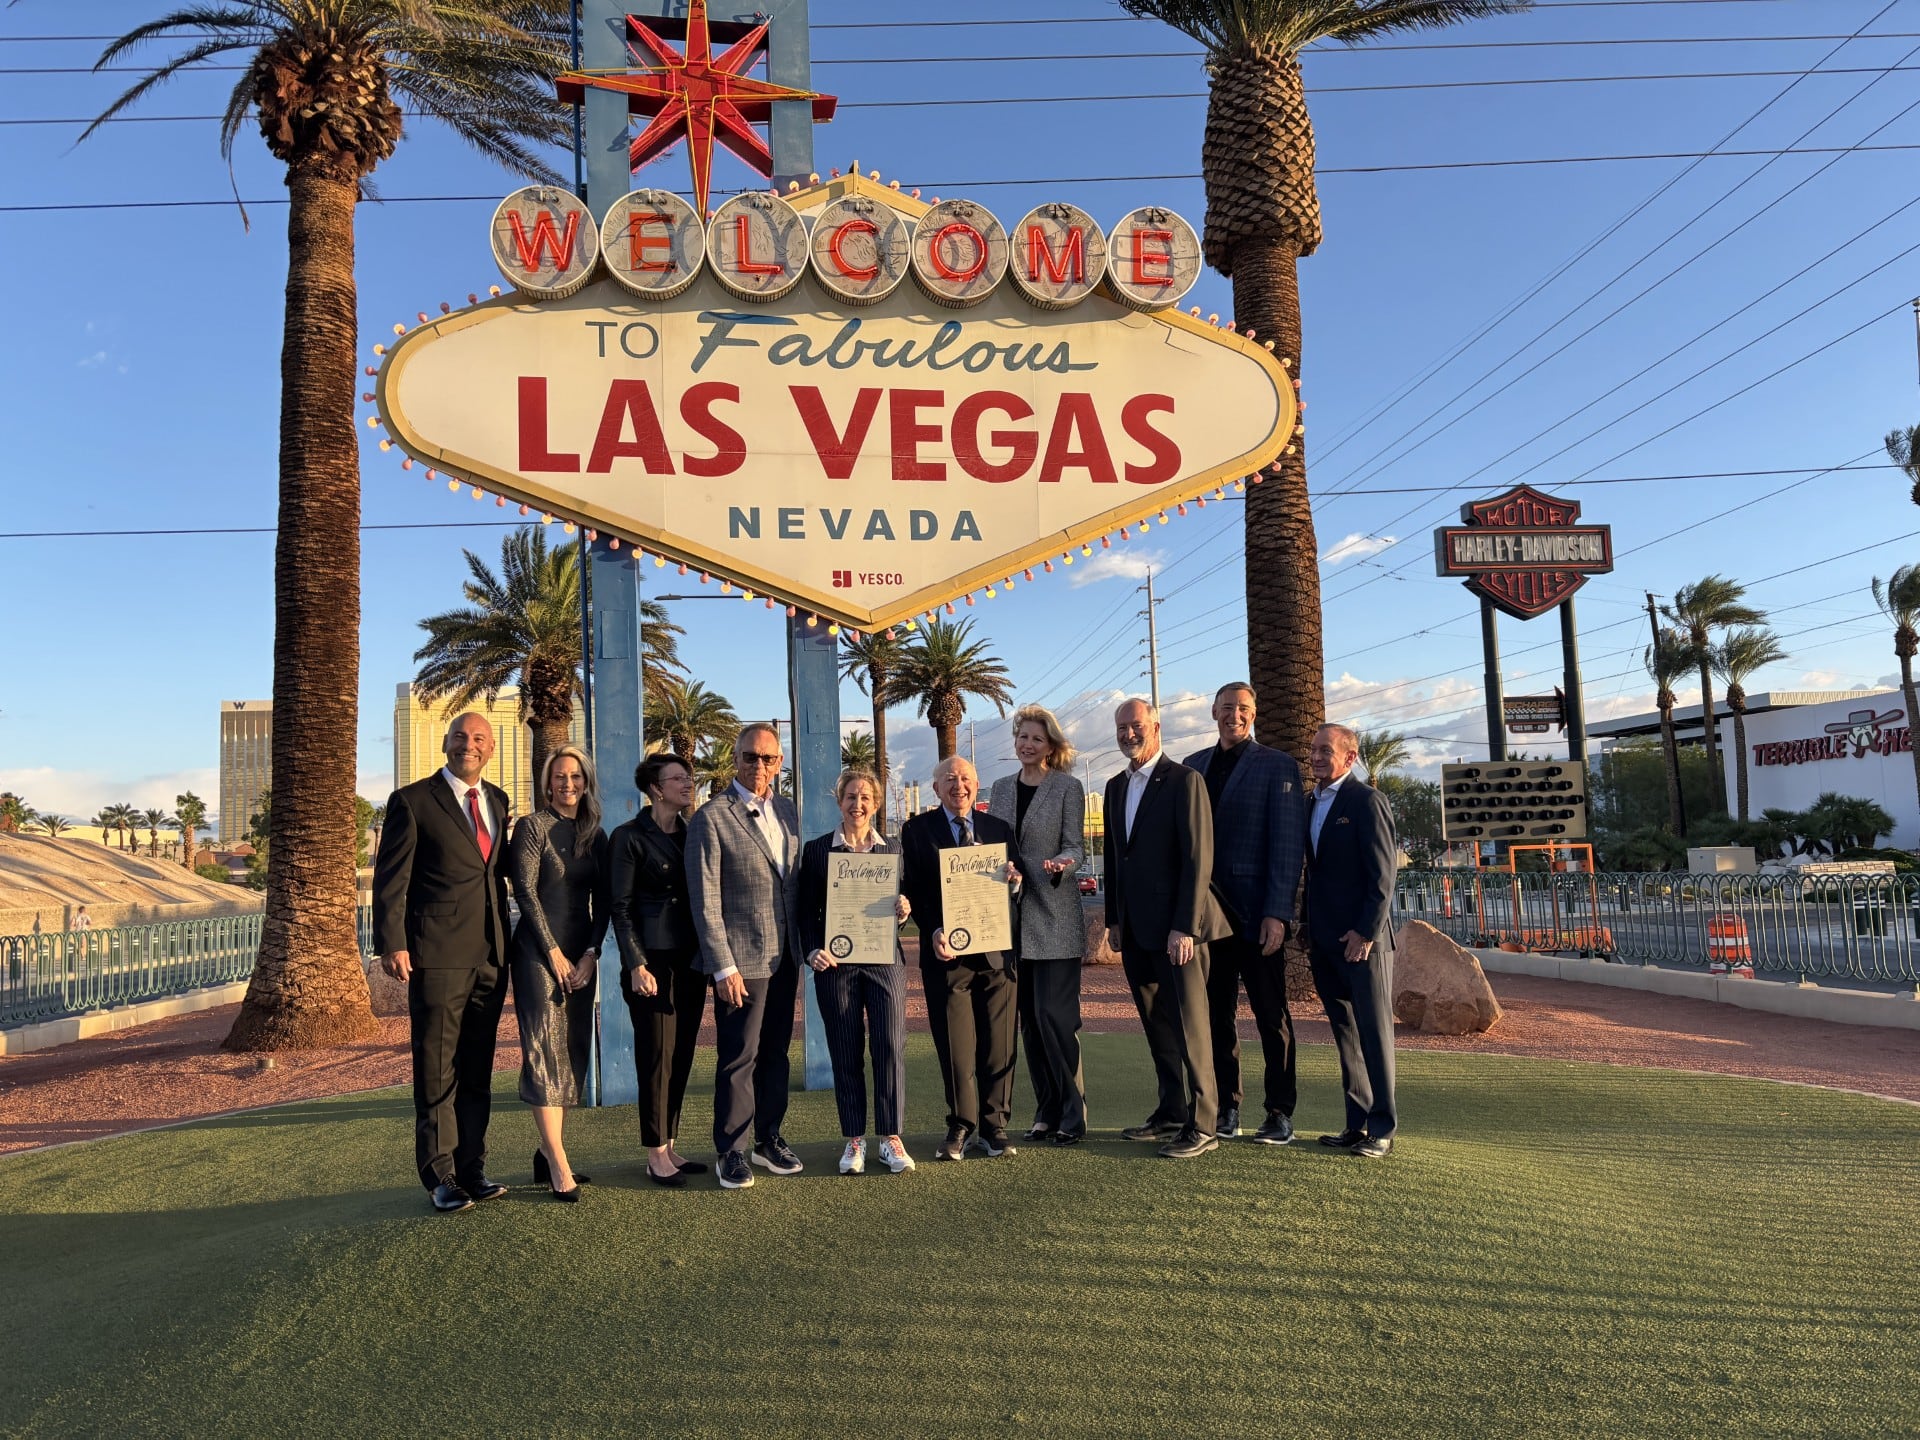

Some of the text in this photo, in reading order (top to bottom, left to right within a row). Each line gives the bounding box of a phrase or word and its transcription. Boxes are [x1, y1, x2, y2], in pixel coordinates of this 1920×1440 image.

[506, 208, 1175, 288] WELCOME
[585, 311, 1099, 374] TO Fabulous
[517, 376, 1182, 484] LAS VEGAS
[728, 506, 983, 542] NEVADA
[1486, 496, 1565, 526] MOTOR
[1453, 534, 1604, 563] HARLEY-DAVIDSON
[858, 572, 903, 585] YESCO
[1491, 572, 1568, 605] CYCLES
[233, 701, 246, 710] W
[1752, 735, 1849, 766] TERRIBLE
